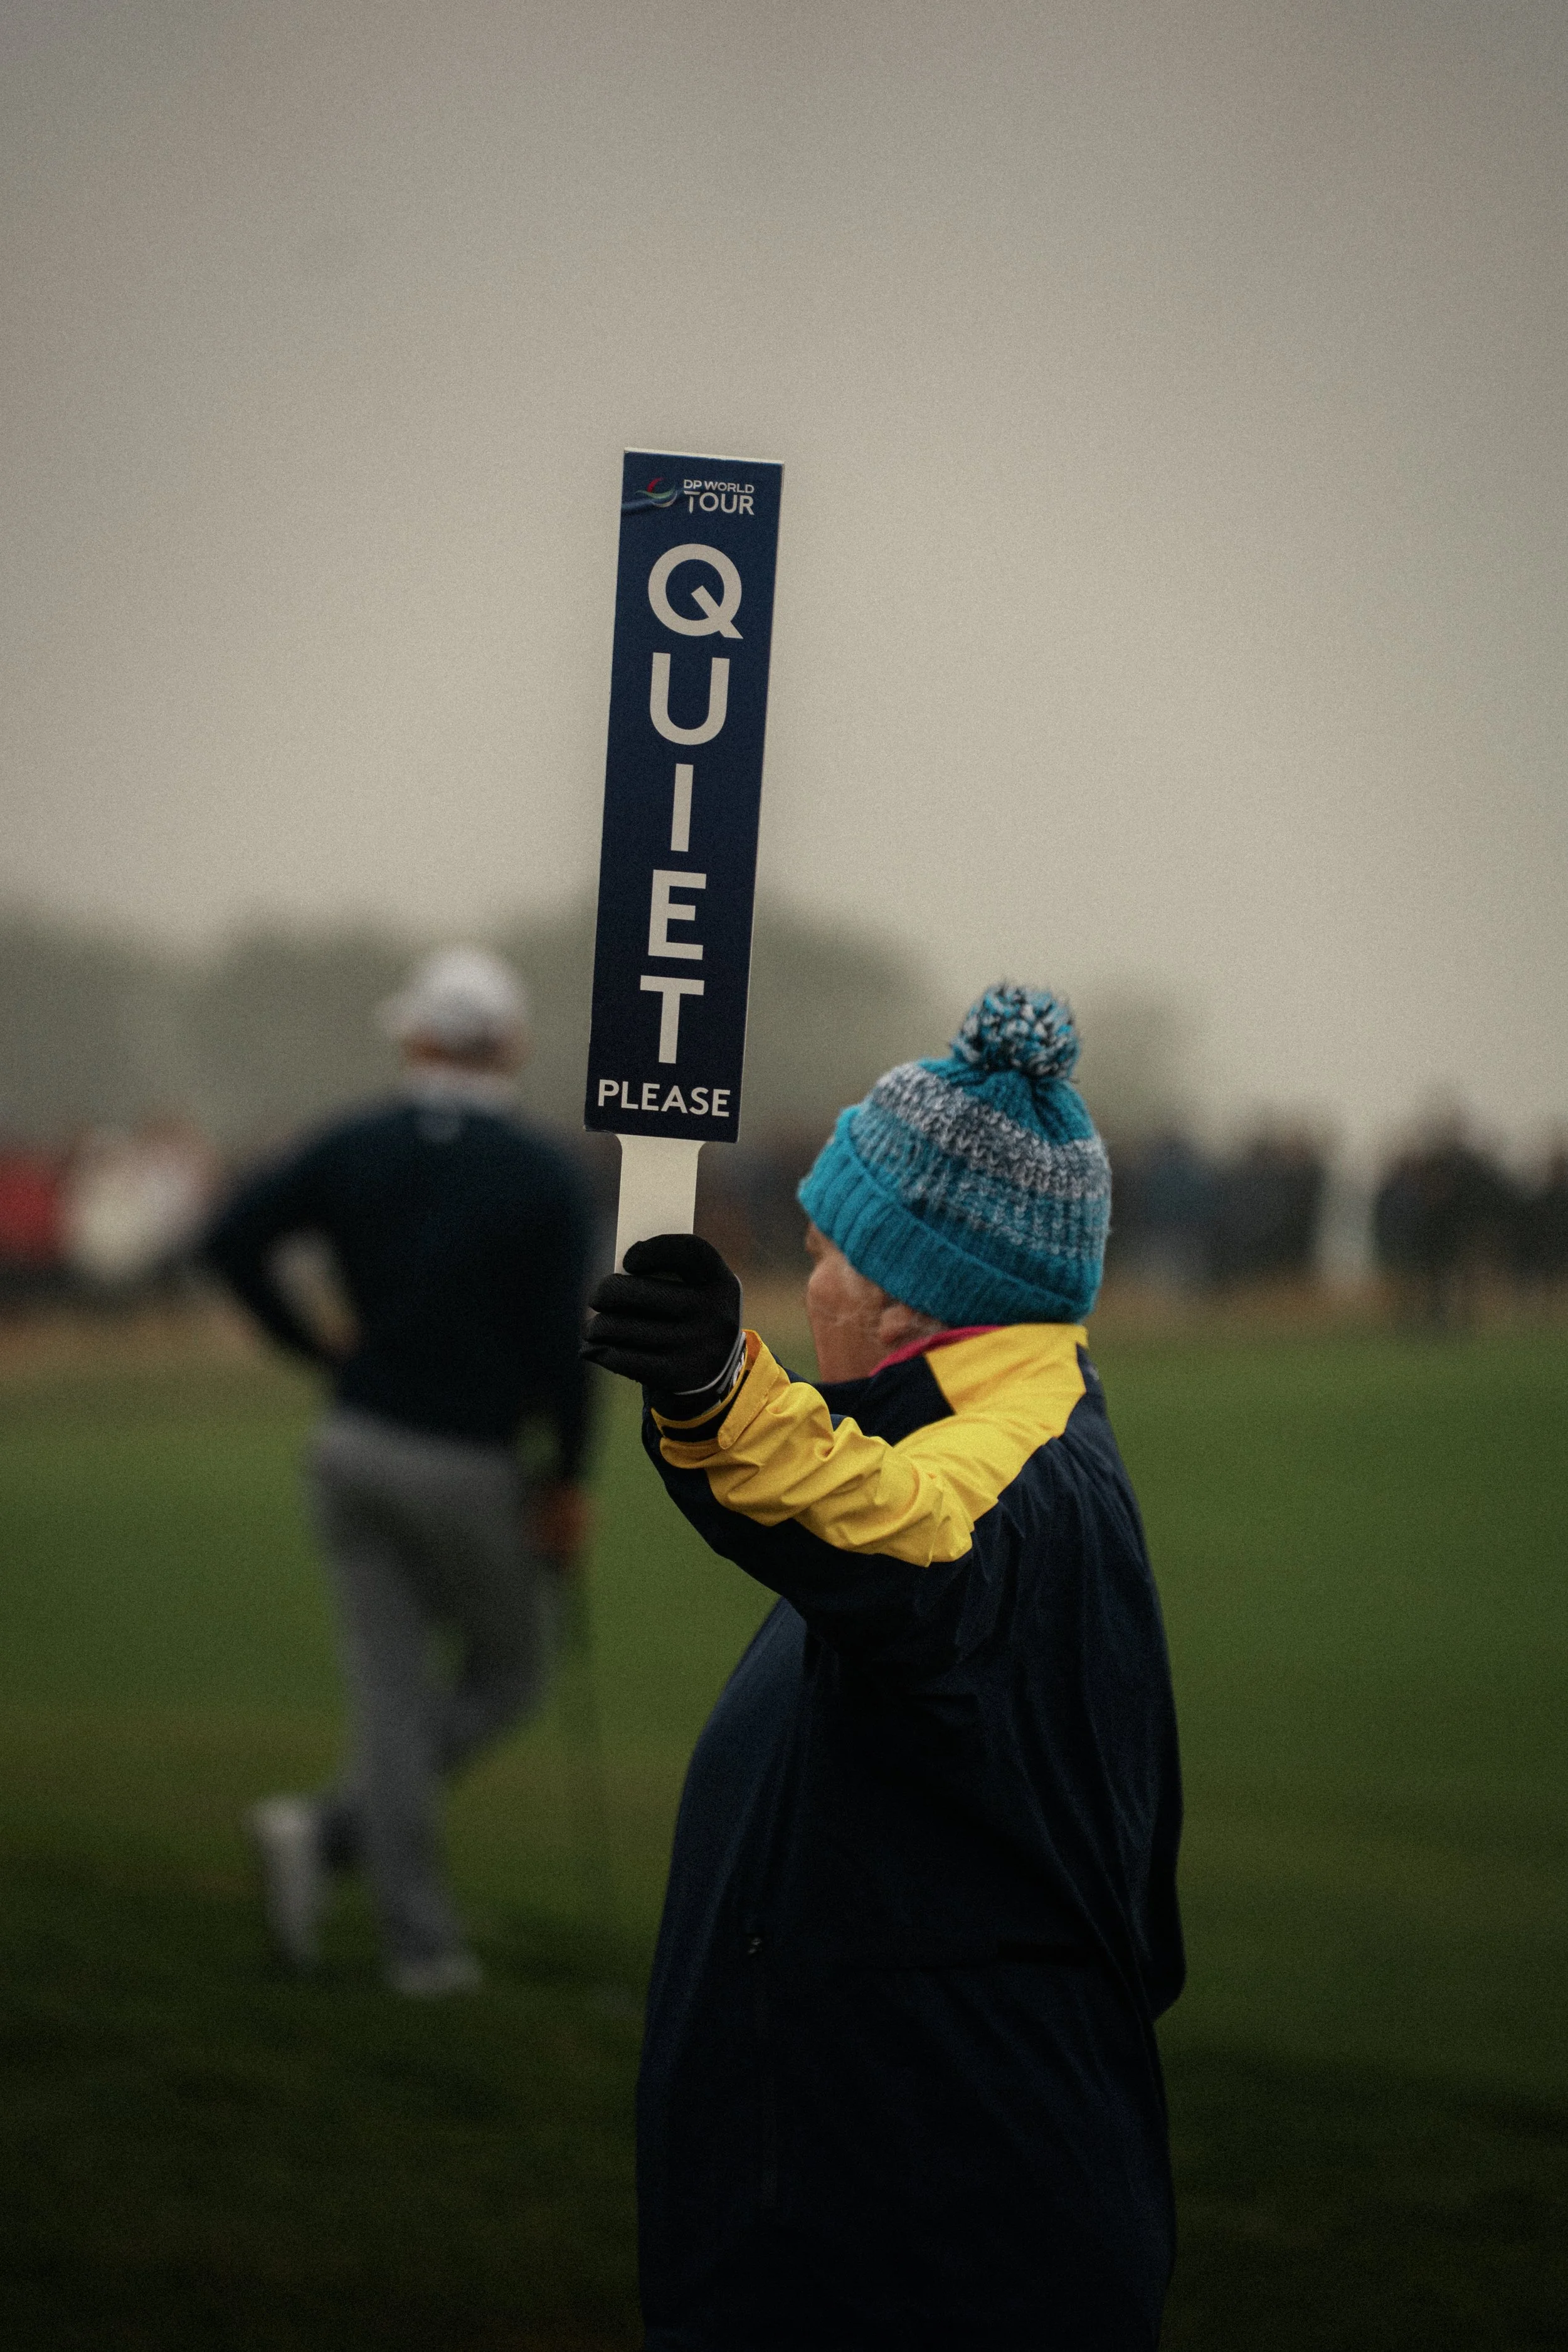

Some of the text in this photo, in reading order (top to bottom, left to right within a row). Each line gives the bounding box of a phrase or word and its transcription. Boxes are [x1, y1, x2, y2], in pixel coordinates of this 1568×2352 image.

[684, 479, 755, 494] DP WORLD
[684, 490, 755, 515] TOUR
[640, 543, 744, 1064] QUIET
[598, 1079, 731, 1117] PLEASE
